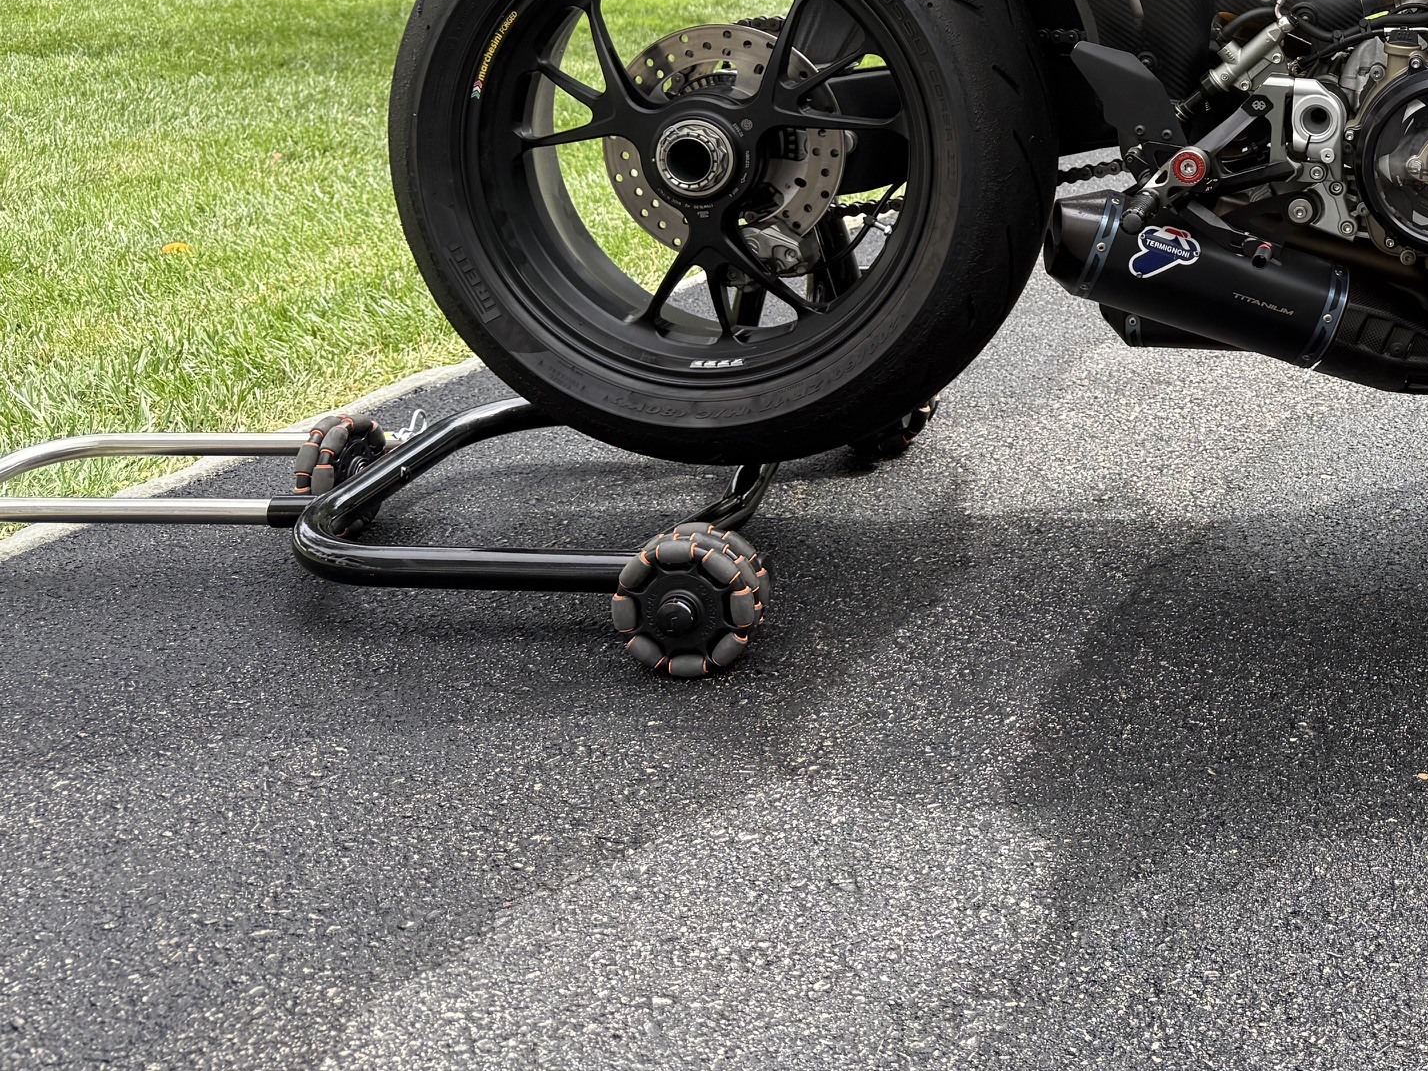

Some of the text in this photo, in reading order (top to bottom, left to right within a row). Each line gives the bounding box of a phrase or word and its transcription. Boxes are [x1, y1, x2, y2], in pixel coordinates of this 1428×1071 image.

[477, 11, 518, 83] marchesini FORGED
[1145, 238, 1190, 259] TERMIGNONI
[1232, 291, 1294, 317] TITANIUM
